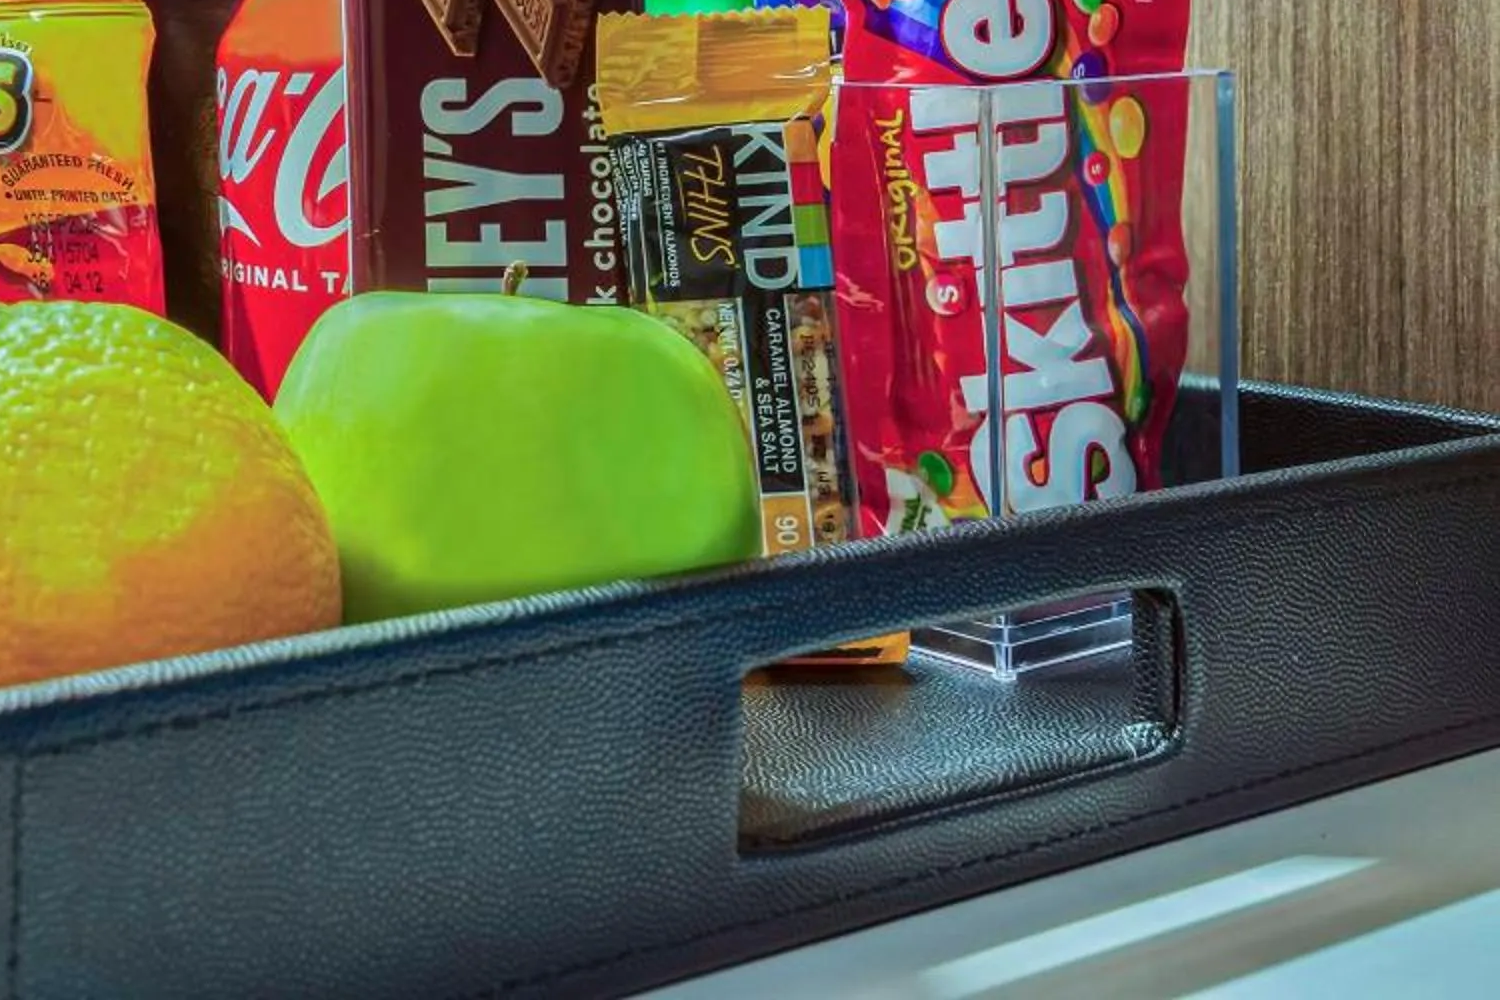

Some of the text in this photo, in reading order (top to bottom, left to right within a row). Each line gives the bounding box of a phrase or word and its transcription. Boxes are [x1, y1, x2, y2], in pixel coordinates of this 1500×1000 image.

[1, 153, 83, 188] GUARANTEED
[50, 189, 100, 204] PRINTED
[656, 156, 675, 227] INGREDIENT
[682, 144, 736, 266] THINS
[731, 124, 798, 291] KIND
[665, 230, 681, 288] ALMONDS
[754, 376, 781, 474] & SEA SALT
[765, 307, 798, 475] CARAMEL ALMOND
[774, 514, 800, 545] 90
